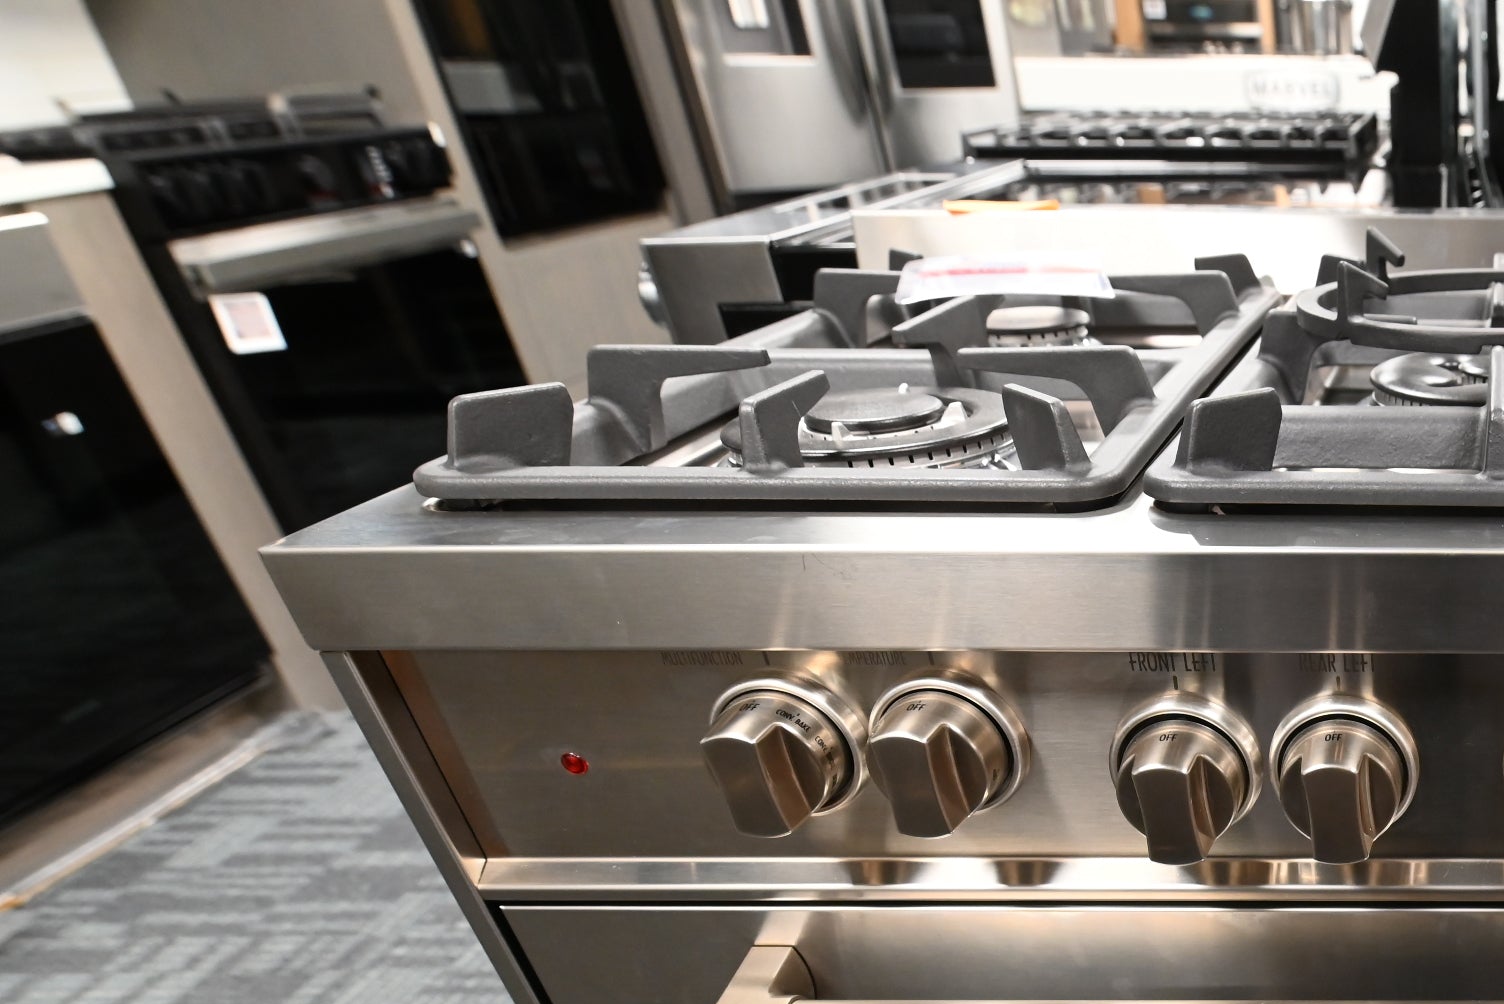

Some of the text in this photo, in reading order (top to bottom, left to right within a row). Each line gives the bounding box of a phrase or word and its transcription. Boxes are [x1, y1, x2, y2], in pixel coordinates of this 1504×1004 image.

[661, 651, 744, 666] MULTIFUNCTION
[1128, 652, 1217, 672] FRONT LEFT
[1299, 653, 1376, 673] REAR LEFT
[739, 702, 760, 712] OFF
[906, 703, 926, 712] OFF
[794, 717, 812, 735] BAKE
[1159, 733, 1178, 742] OFF
[1324, 733, 1343, 742] OFF
